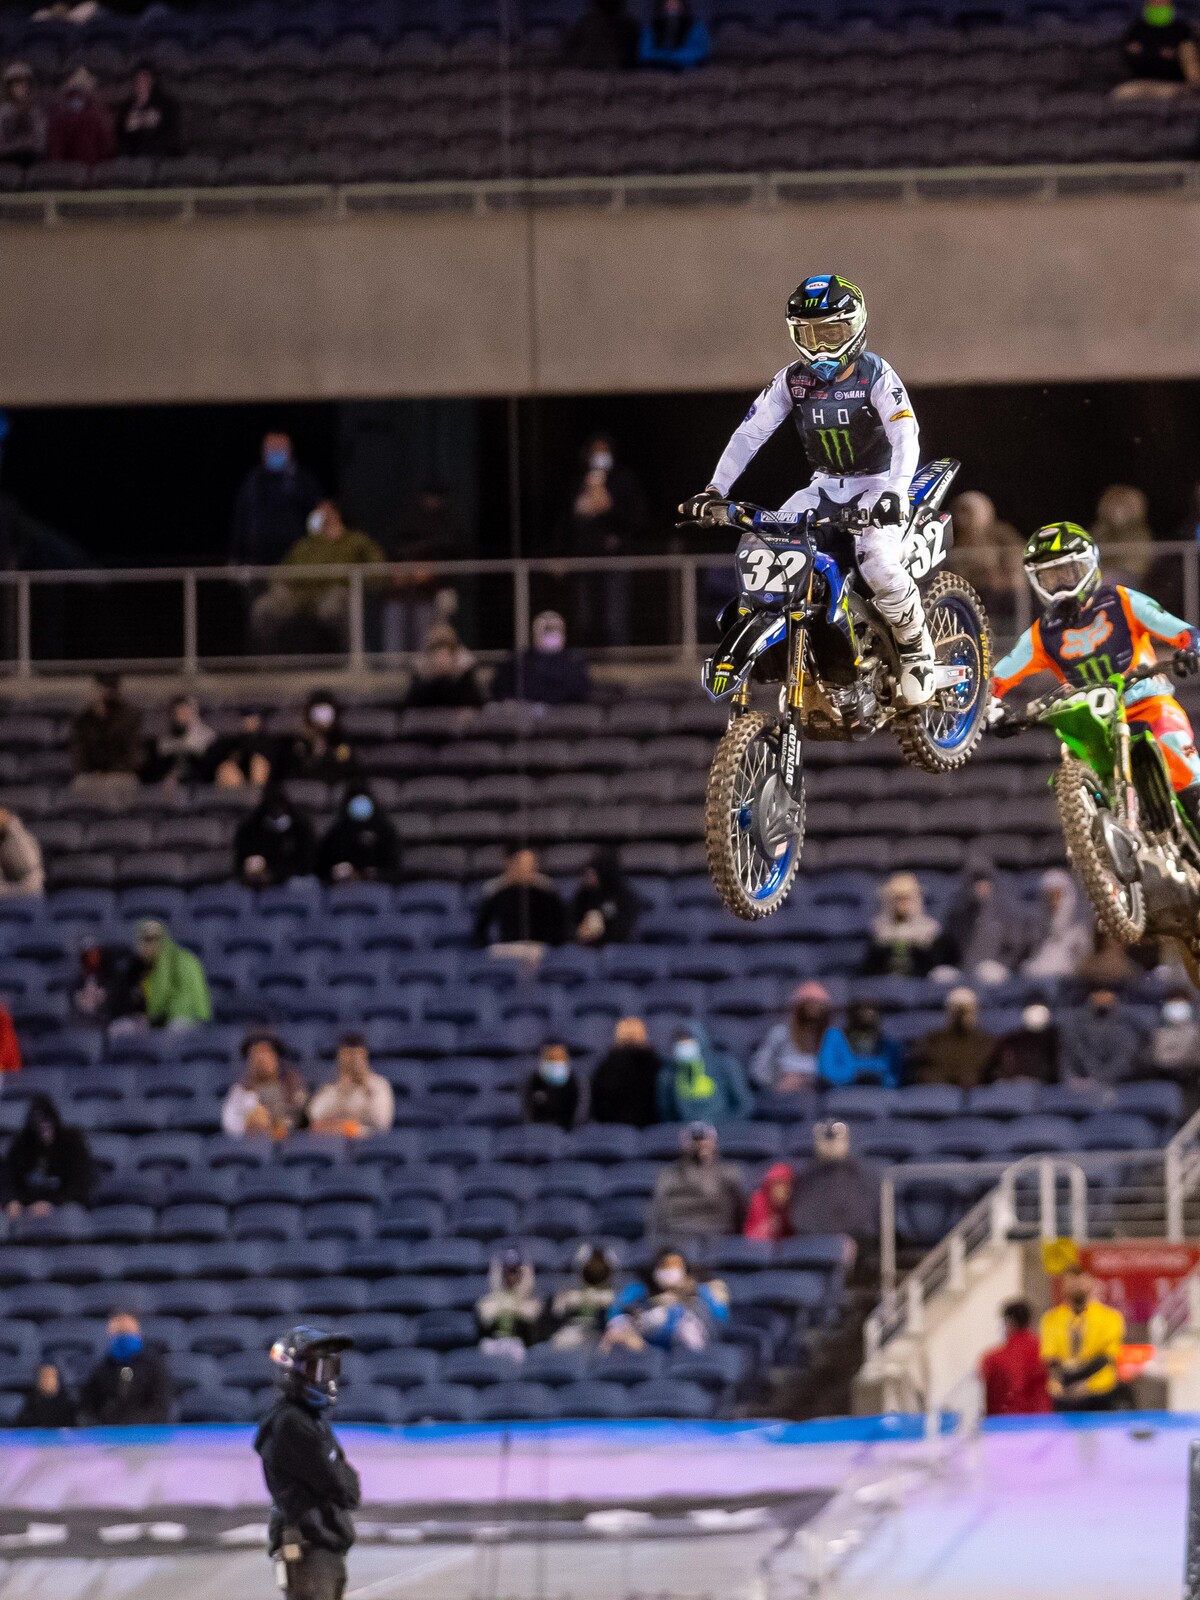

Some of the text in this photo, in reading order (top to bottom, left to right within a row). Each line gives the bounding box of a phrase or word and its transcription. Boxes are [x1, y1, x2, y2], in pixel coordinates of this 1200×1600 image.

[743, 549, 806, 592] 32
[908, 521, 946, 579] 32
[786, 723, 797, 786] DUNLOP
